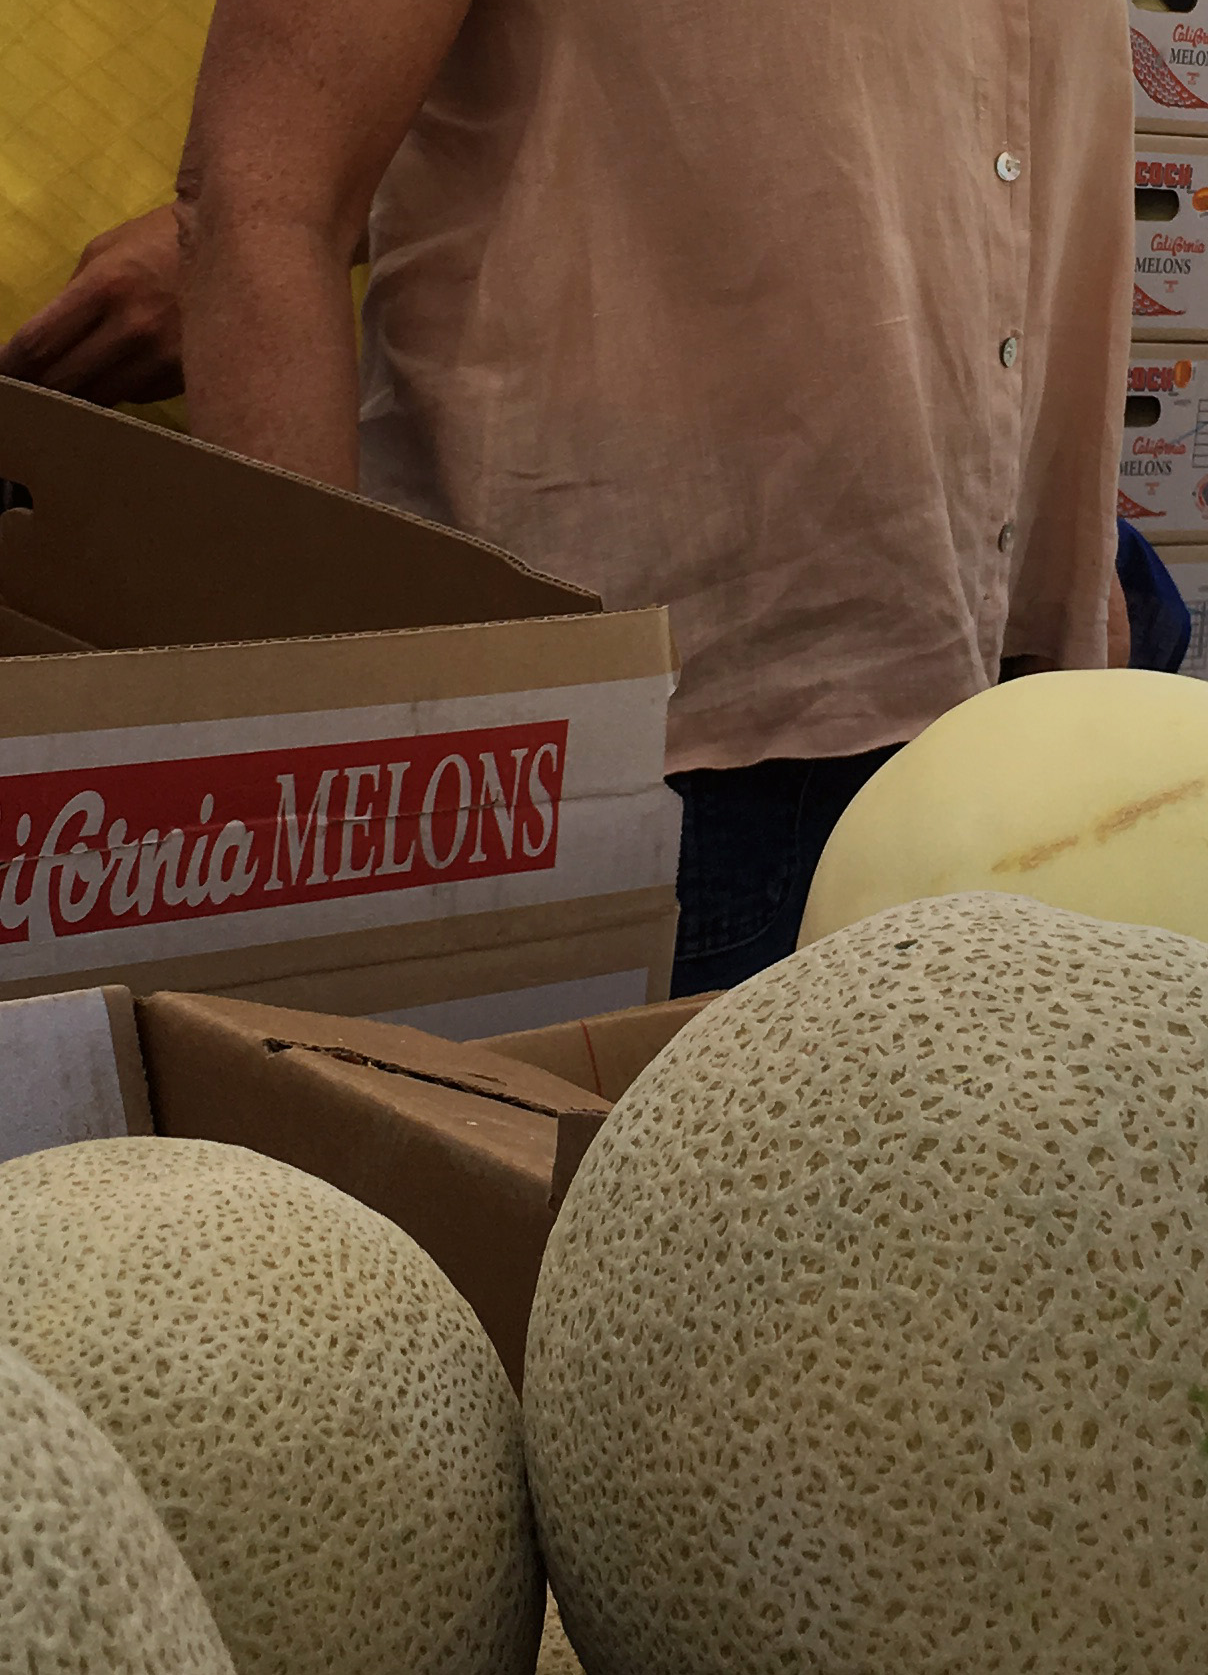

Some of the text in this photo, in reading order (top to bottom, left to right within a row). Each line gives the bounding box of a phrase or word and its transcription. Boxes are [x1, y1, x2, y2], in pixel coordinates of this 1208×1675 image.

[1151, 233, 1206, 256] California
[1135, 257, 1191, 274] MELONS
[264, 743, 558, 891] MELONS
